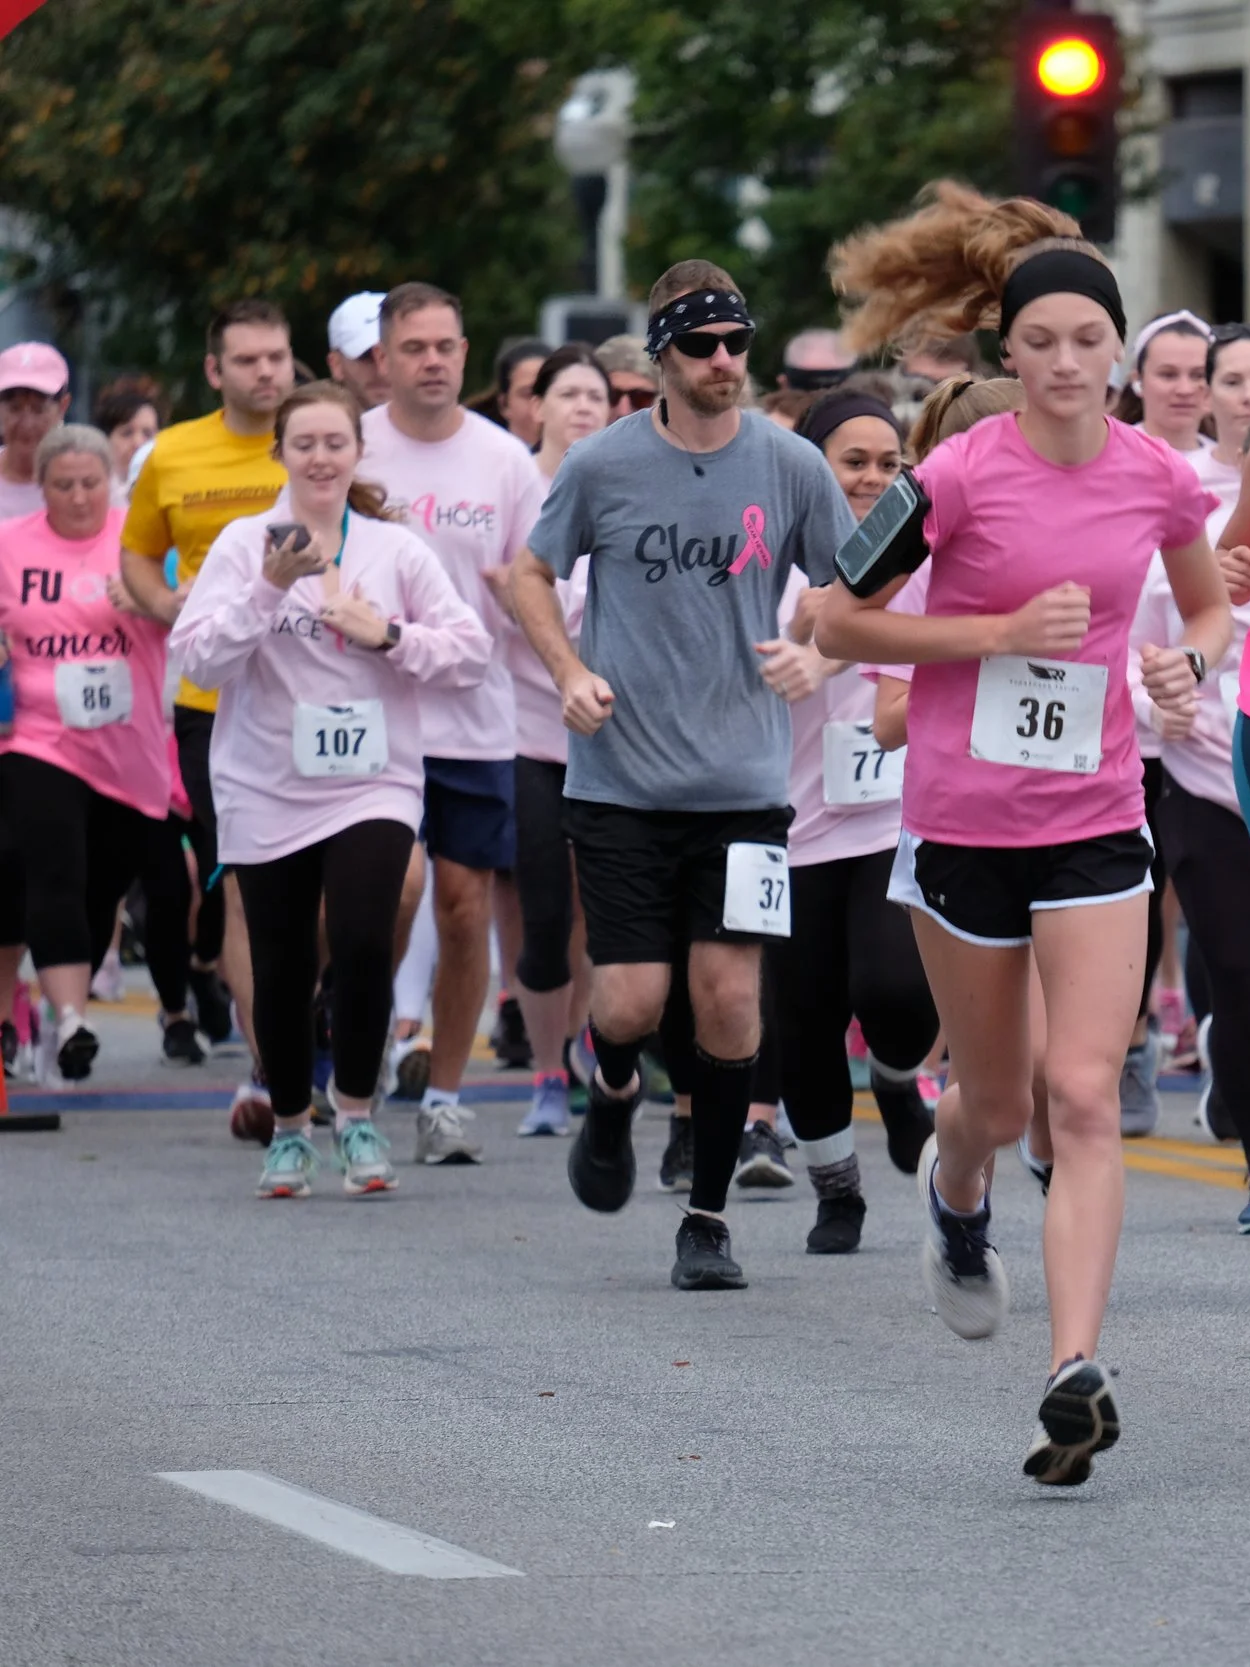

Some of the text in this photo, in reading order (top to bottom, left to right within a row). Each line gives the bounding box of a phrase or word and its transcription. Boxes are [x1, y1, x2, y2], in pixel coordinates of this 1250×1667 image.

[436, 500, 495, 532] HOPE
[634, 523, 738, 587] Slay
[21, 567, 63, 606] FU
[82, 683, 112, 712] 86
[1015, 696, 1066, 741] 36
[315, 727, 367, 757] 107
[851, 748, 887, 783] 77
[758, 876, 786, 911] 37
